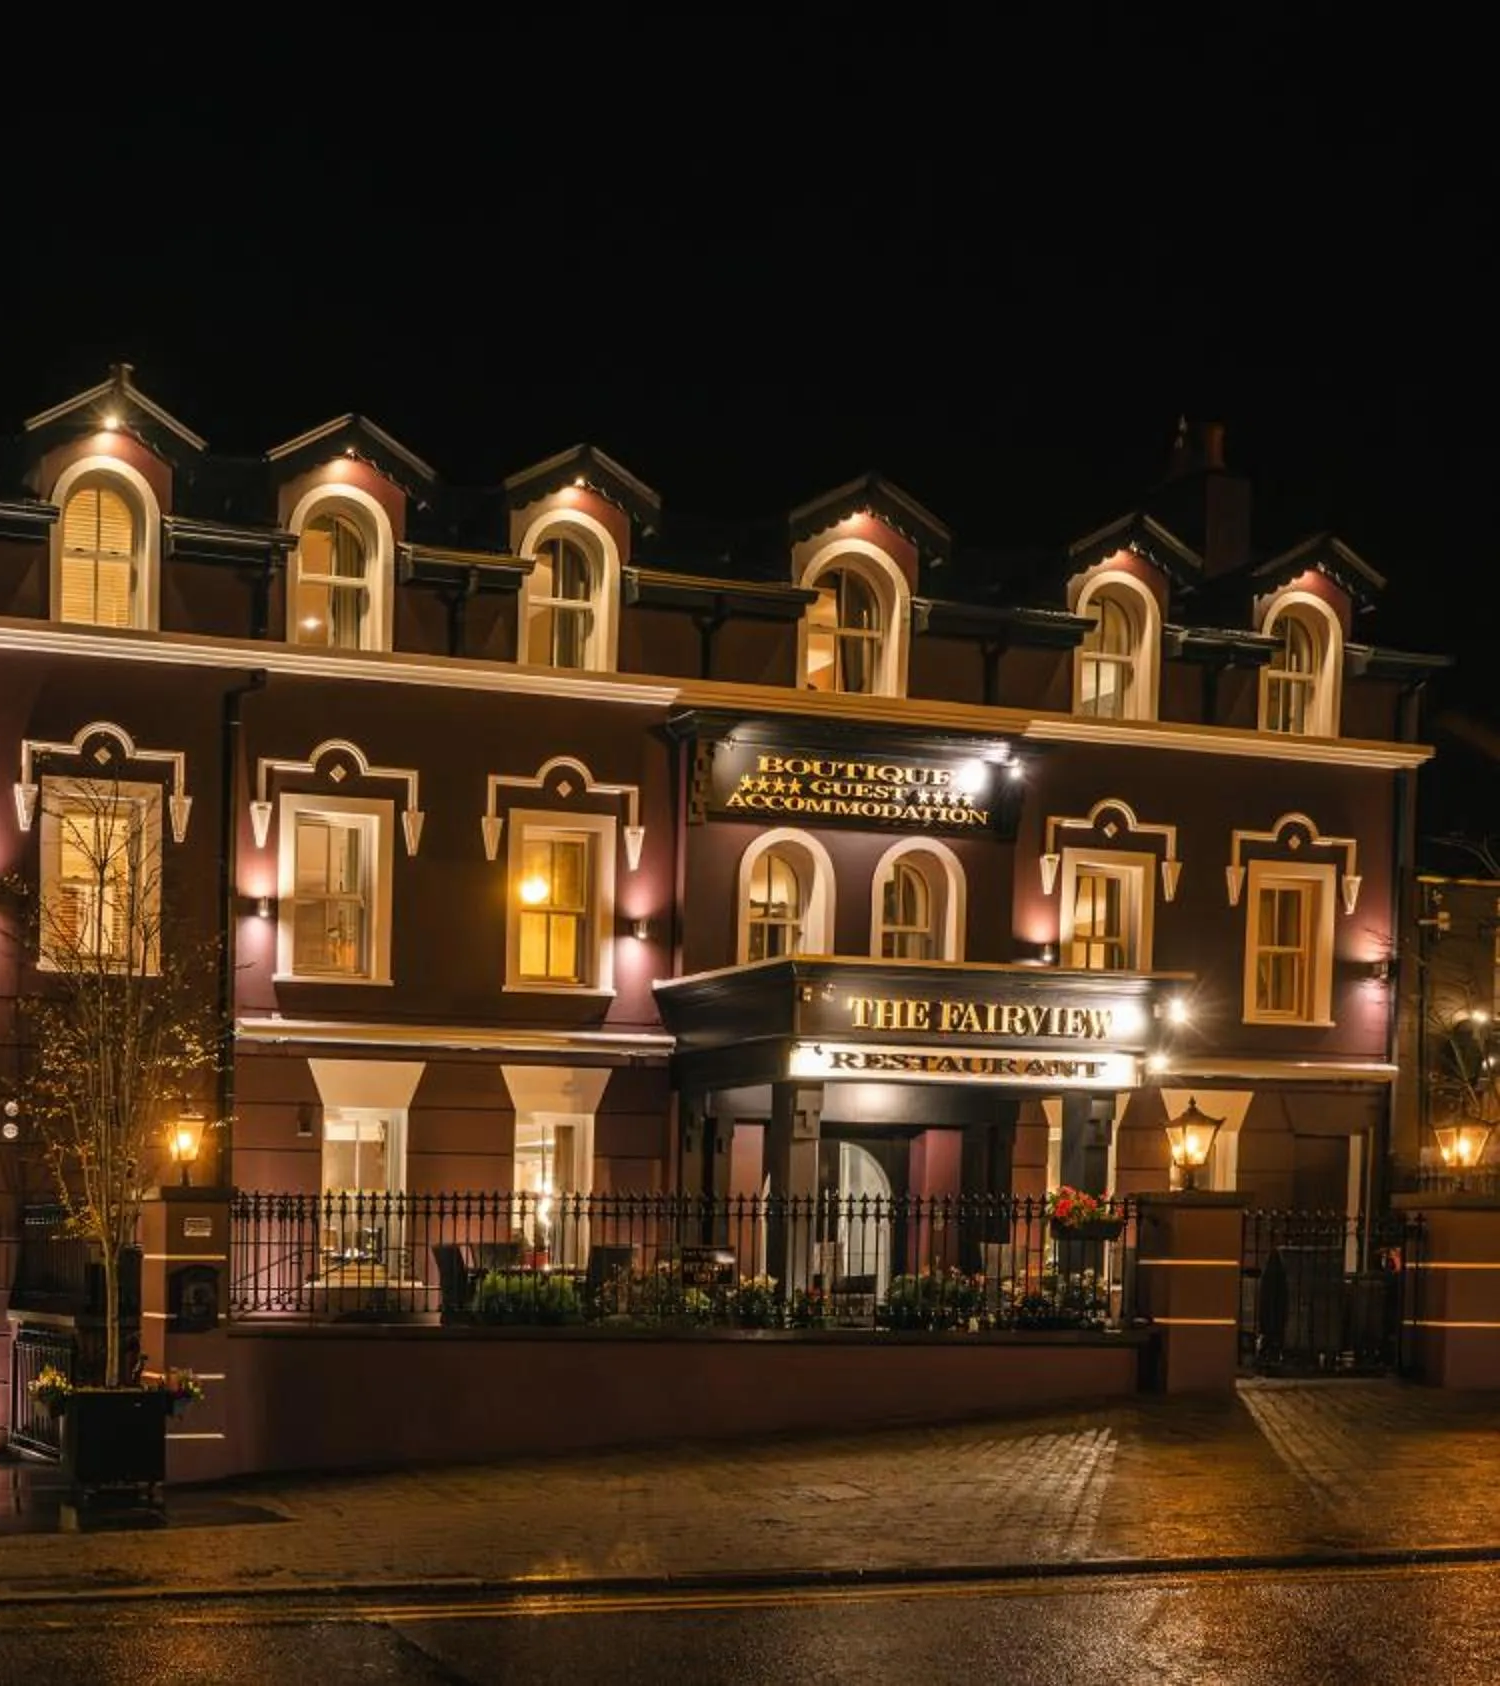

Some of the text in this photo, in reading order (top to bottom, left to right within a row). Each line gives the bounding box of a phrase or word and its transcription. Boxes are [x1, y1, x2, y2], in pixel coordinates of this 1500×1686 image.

[756, 755, 957, 786] BOUTIQUE
[809, 780, 909, 801] GUEST
[725, 791, 989, 825] ACCOMMODATION
[847, 997, 1113, 1039] THE FAIRVIEW
[828, 1050, 1108, 1078] RESTAURANT
